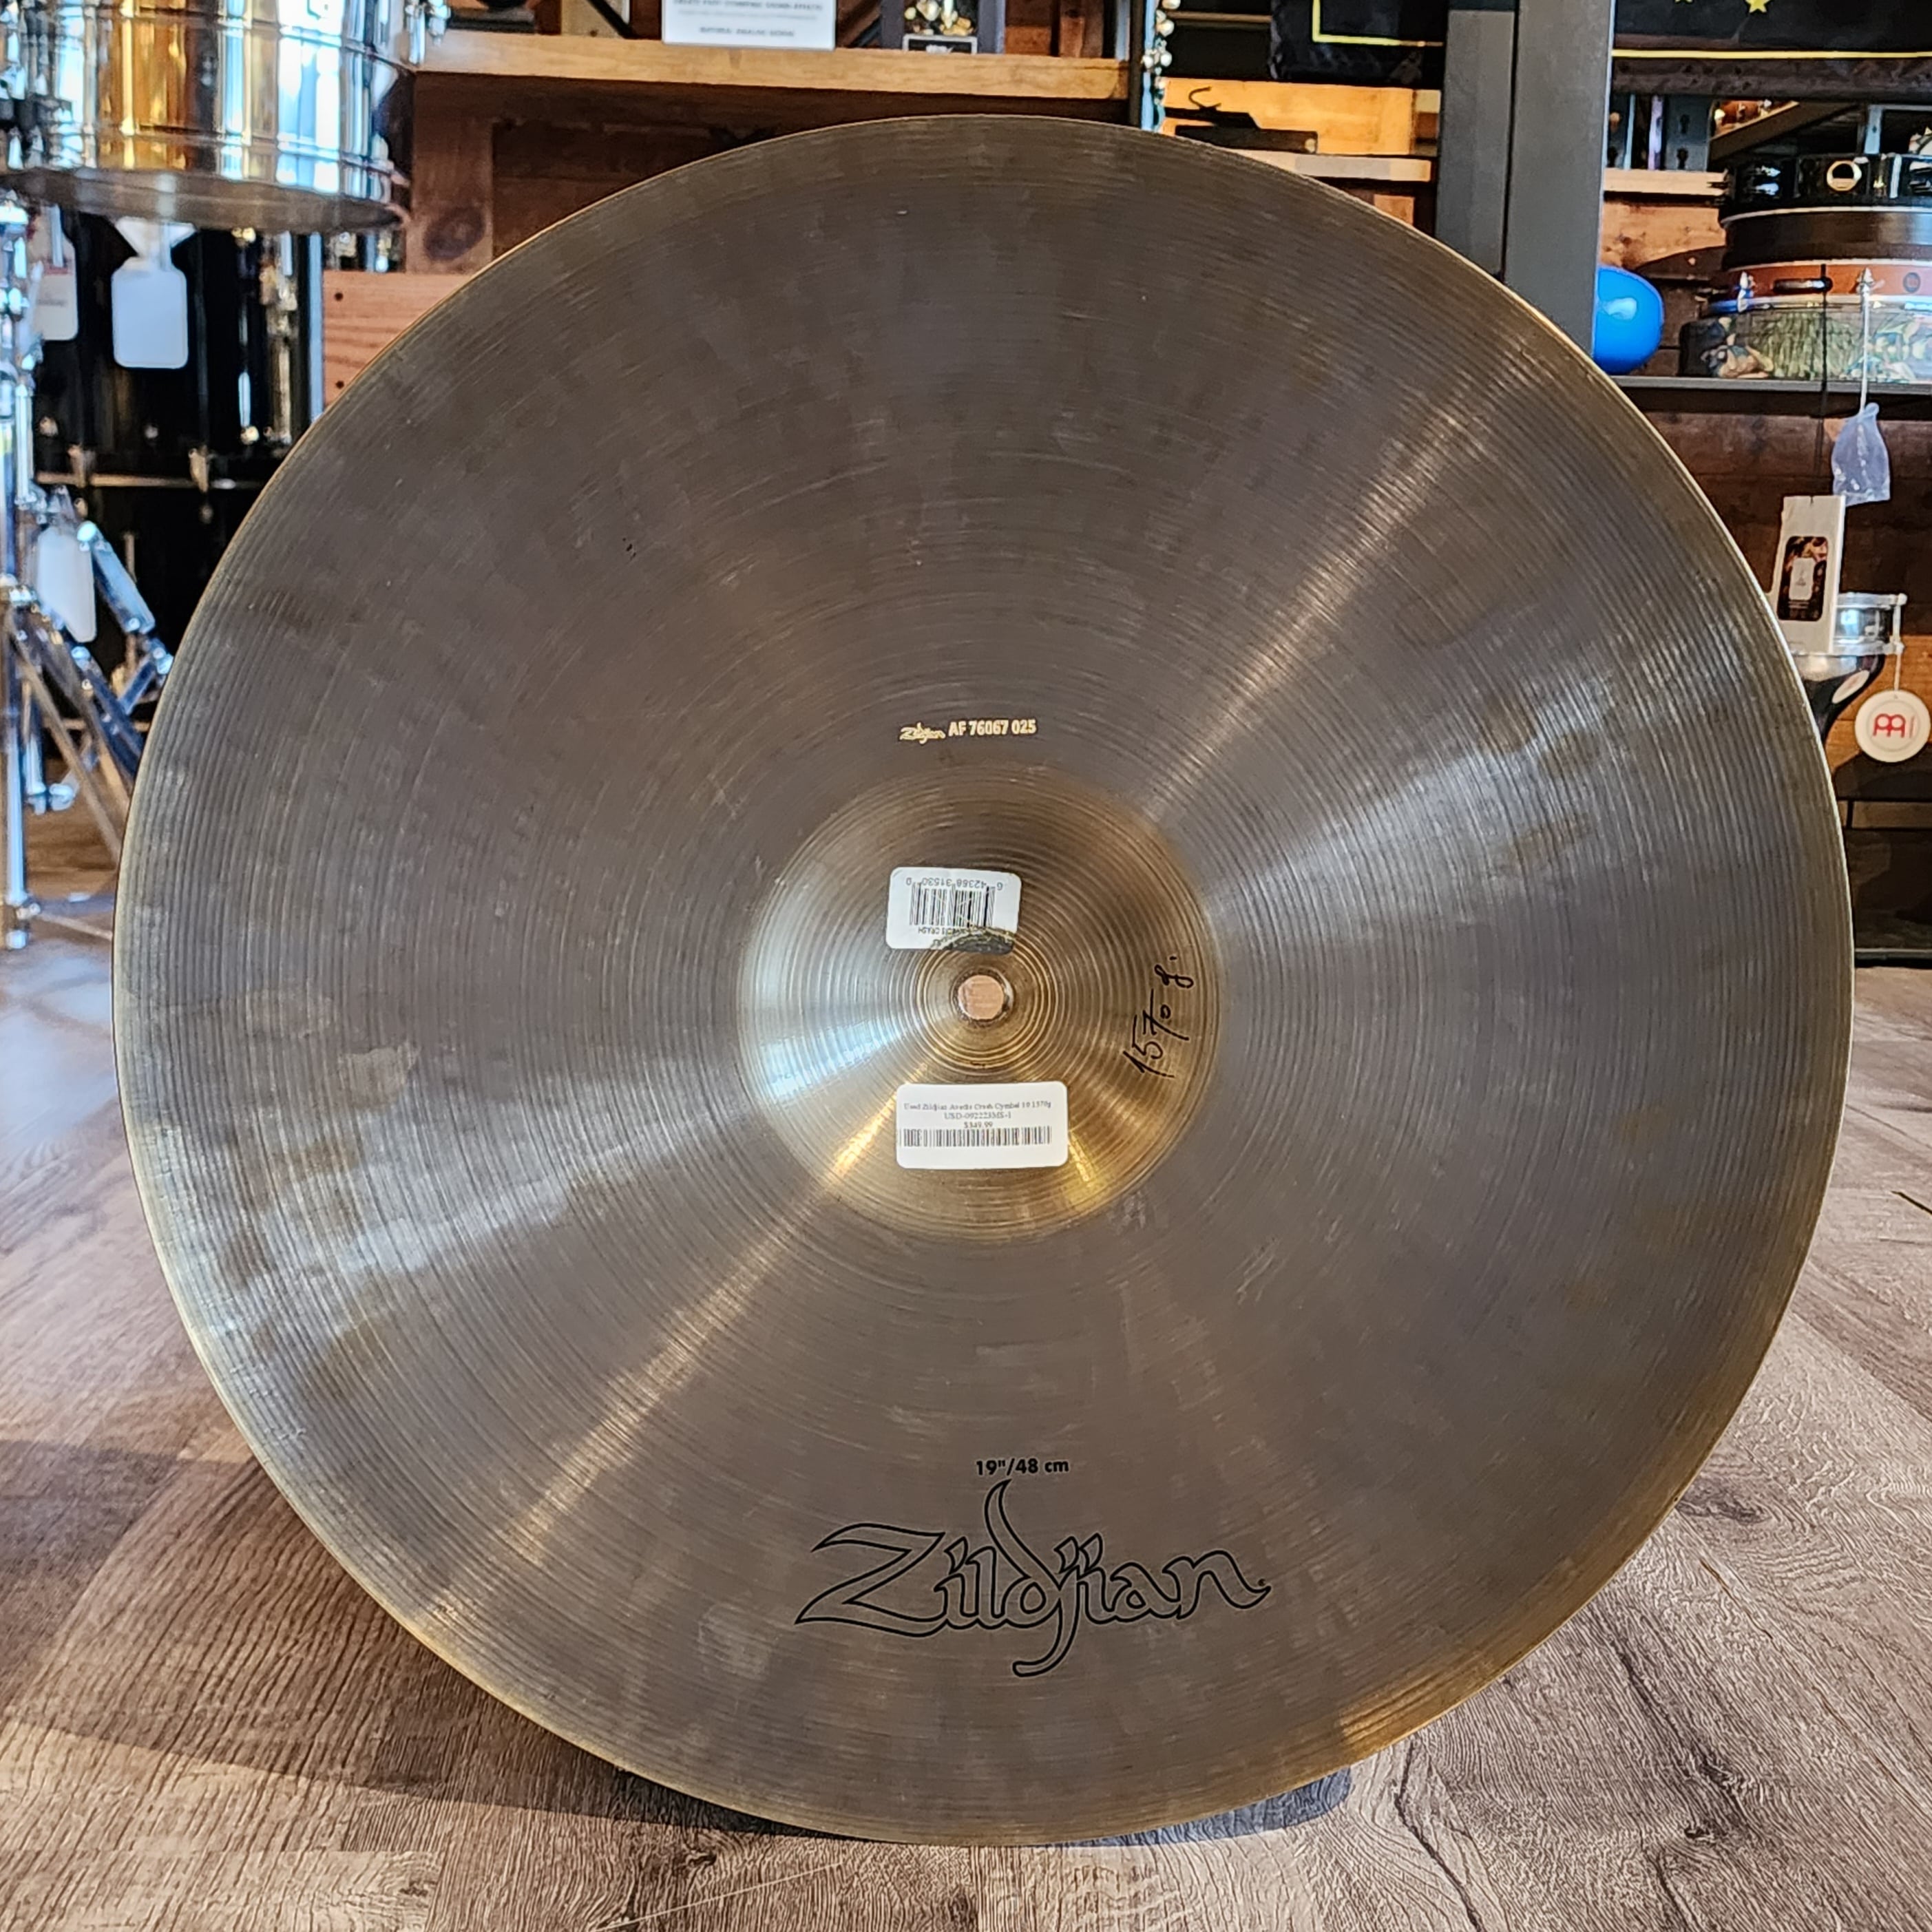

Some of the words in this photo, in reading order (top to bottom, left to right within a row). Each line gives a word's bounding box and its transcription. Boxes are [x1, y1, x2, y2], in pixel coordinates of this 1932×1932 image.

[948, 722, 966, 736] AF
[969, 720, 1009, 735] 76067
[1011, 720, 1036, 734] 025
[1123, 989, 1189, 1078] 1570
[976, 1458, 1038, 1476] 19"/48
[1044, 1461, 1069, 1472] cm
[795, 1479, 1272, 1678] Zildjian
